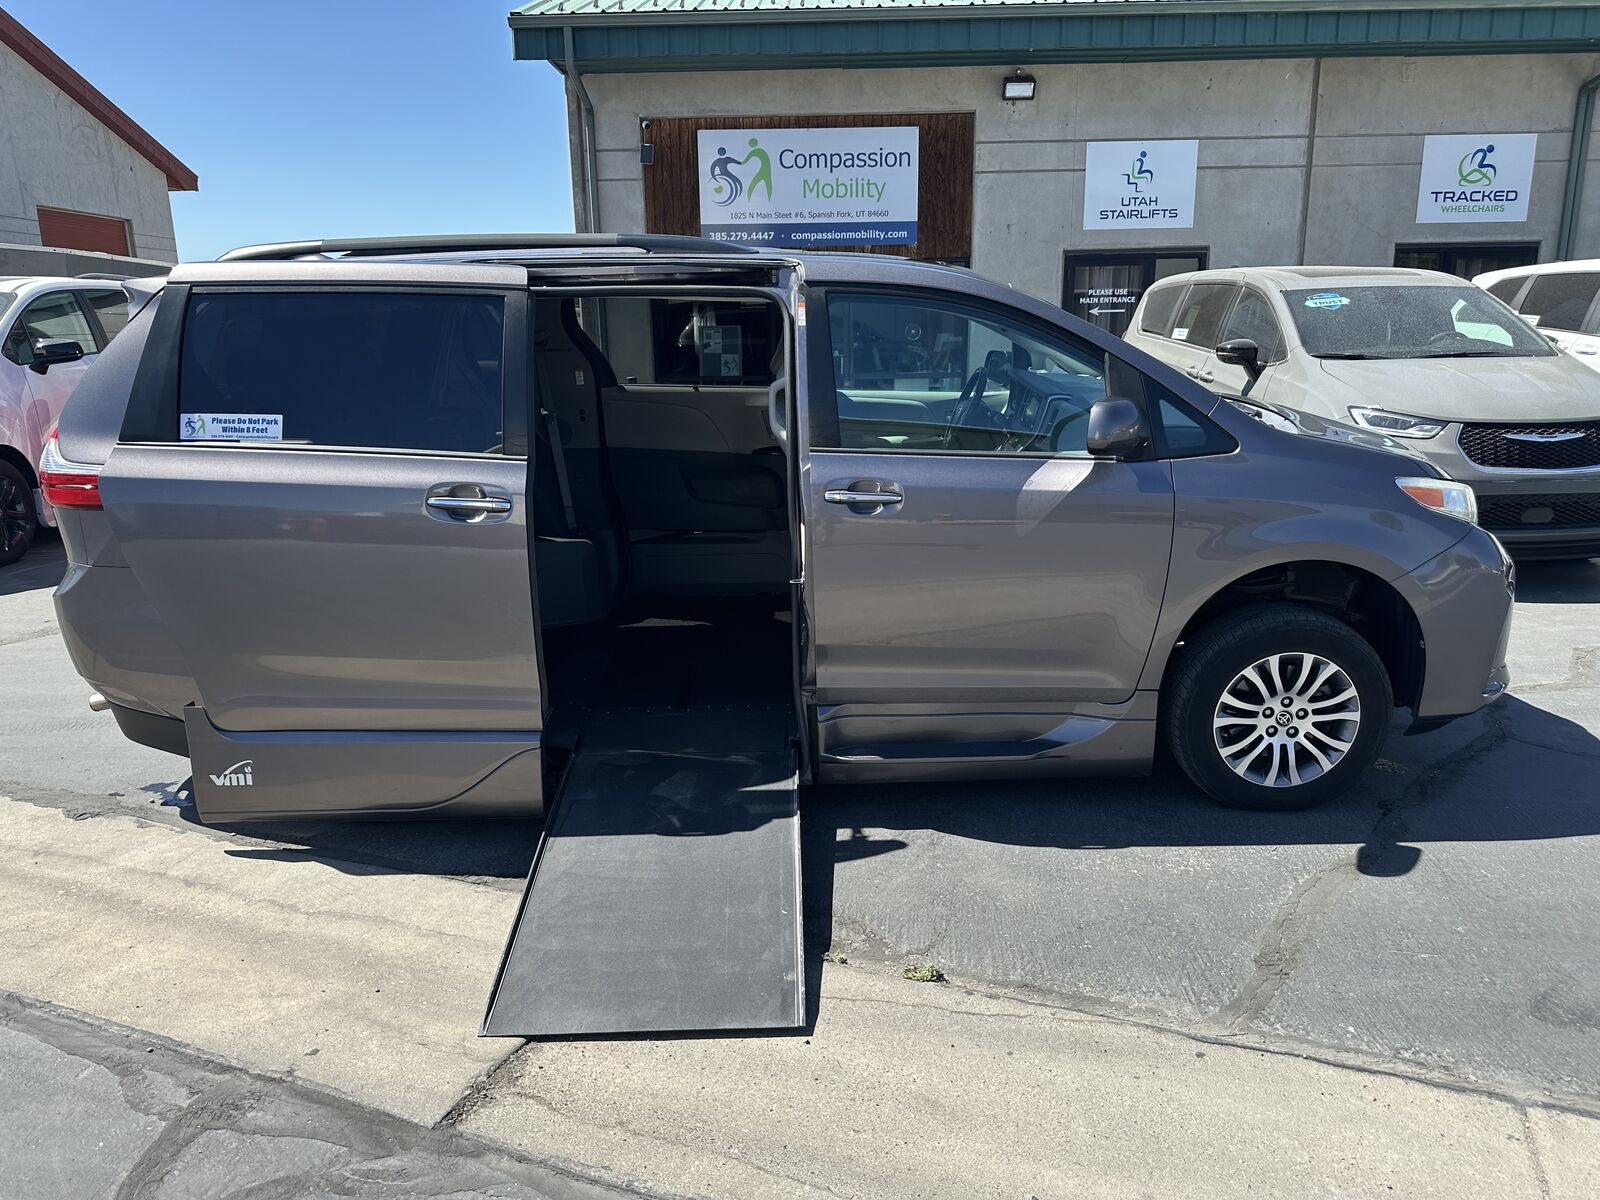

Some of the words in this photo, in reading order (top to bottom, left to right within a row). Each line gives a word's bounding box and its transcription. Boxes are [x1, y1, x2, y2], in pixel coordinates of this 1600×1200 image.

[779, 148, 911, 173] Compassion
[803, 177, 887, 202] Mobility
[1121, 196, 1158, 207] UTAH
[1431, 190, 1518, 203] TRACKED
[1100, 208, 1178, 220] STAIRLIFTS
[1441, 205, 1505, 213] WHEELCHAIRS
[730, 212, 747, 220] 1825
[774, 211, 792, 219] Steet
[794, 211, 806, 220] #6,
[808, 211, 835, 220] Spanish
[837, 210, 854, 219] Fork,
[856, 210, 866, 218] UT
[867, 210, 889, 218] 84660
[709, 231, 775, 241] 385.279.4447
[791, 230, 908, 241] compassionmobility.com
[211, 417, 236, 425] Please
[261, 418, 279, 426] Park
[252, 426, 268, 434] Feet
